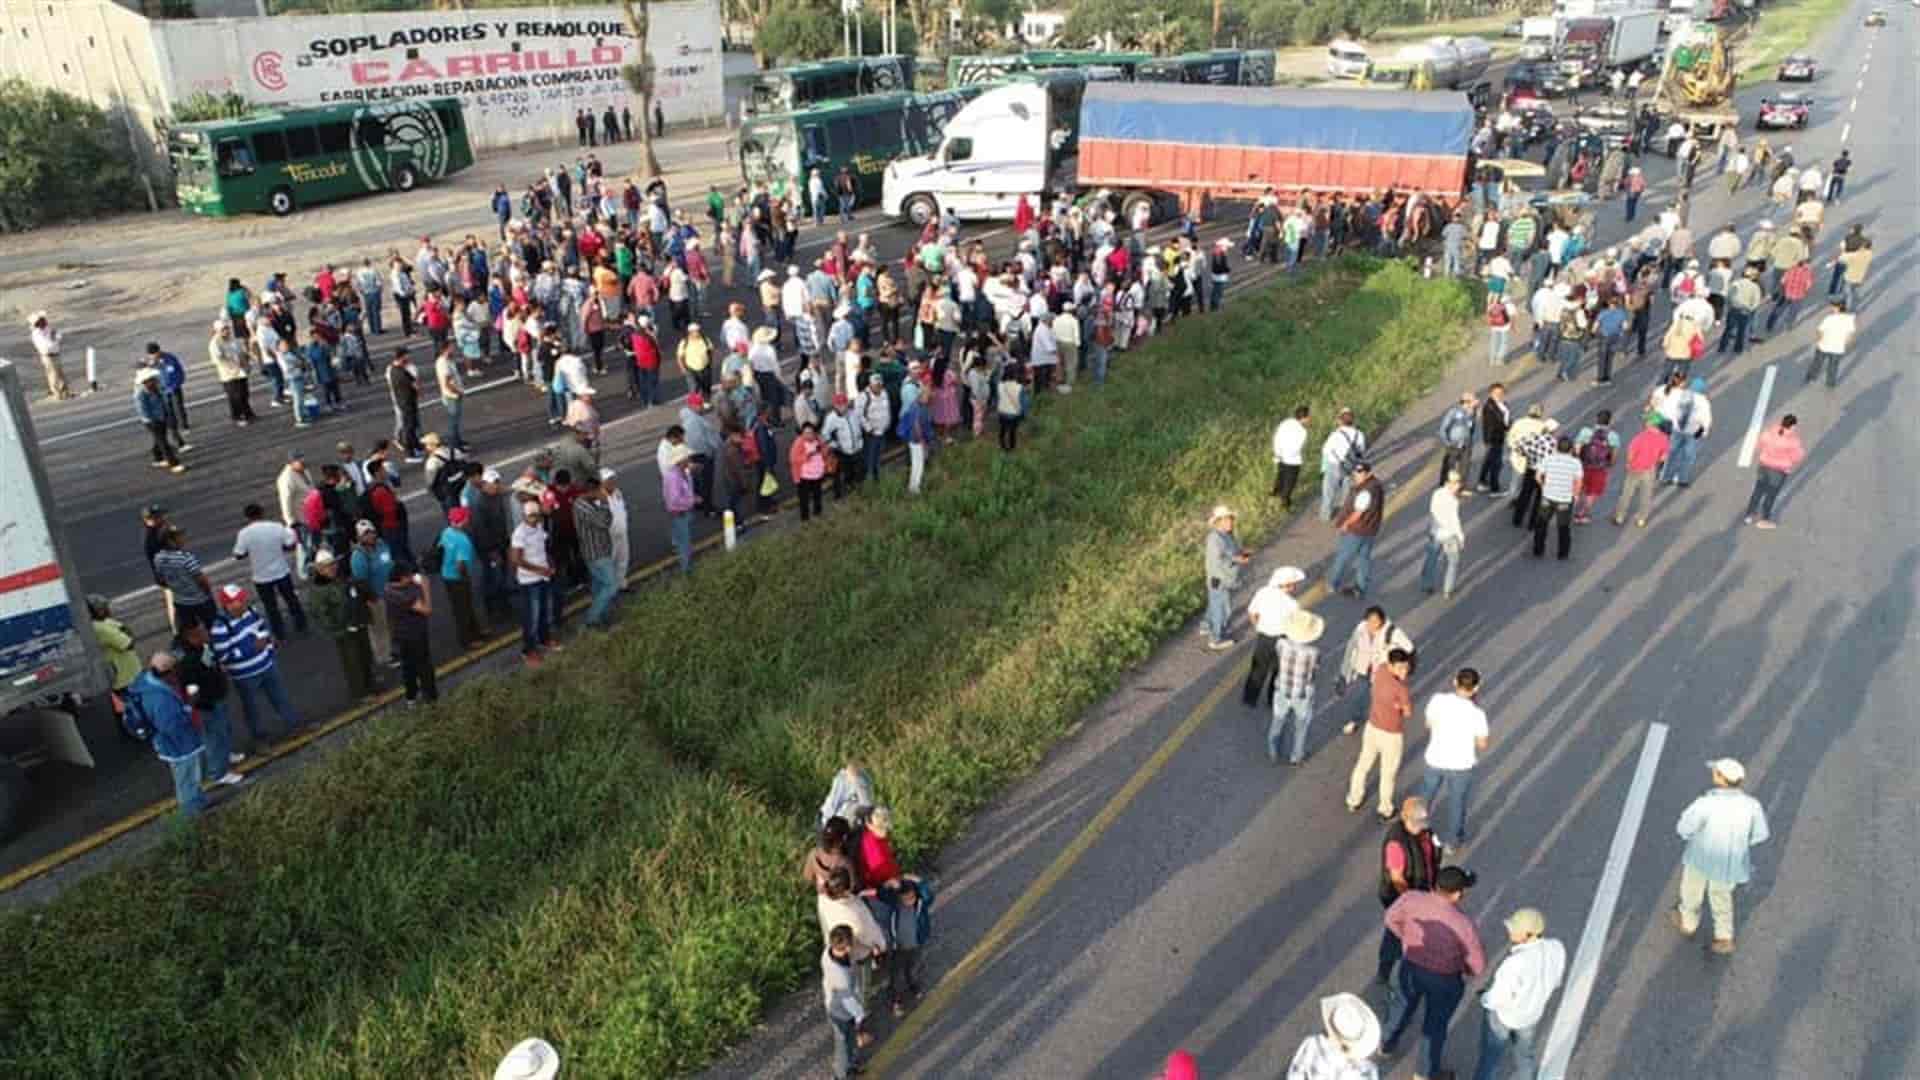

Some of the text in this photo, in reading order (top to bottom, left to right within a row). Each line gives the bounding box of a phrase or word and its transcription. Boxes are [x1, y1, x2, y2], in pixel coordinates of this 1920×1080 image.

[309, 23, 486, 58] SOPLADORES
[495, 23, 508, 37] Y
[353, 46, 623, 84] CARRILLO
[532, 69, 592, 87] COMPRA
